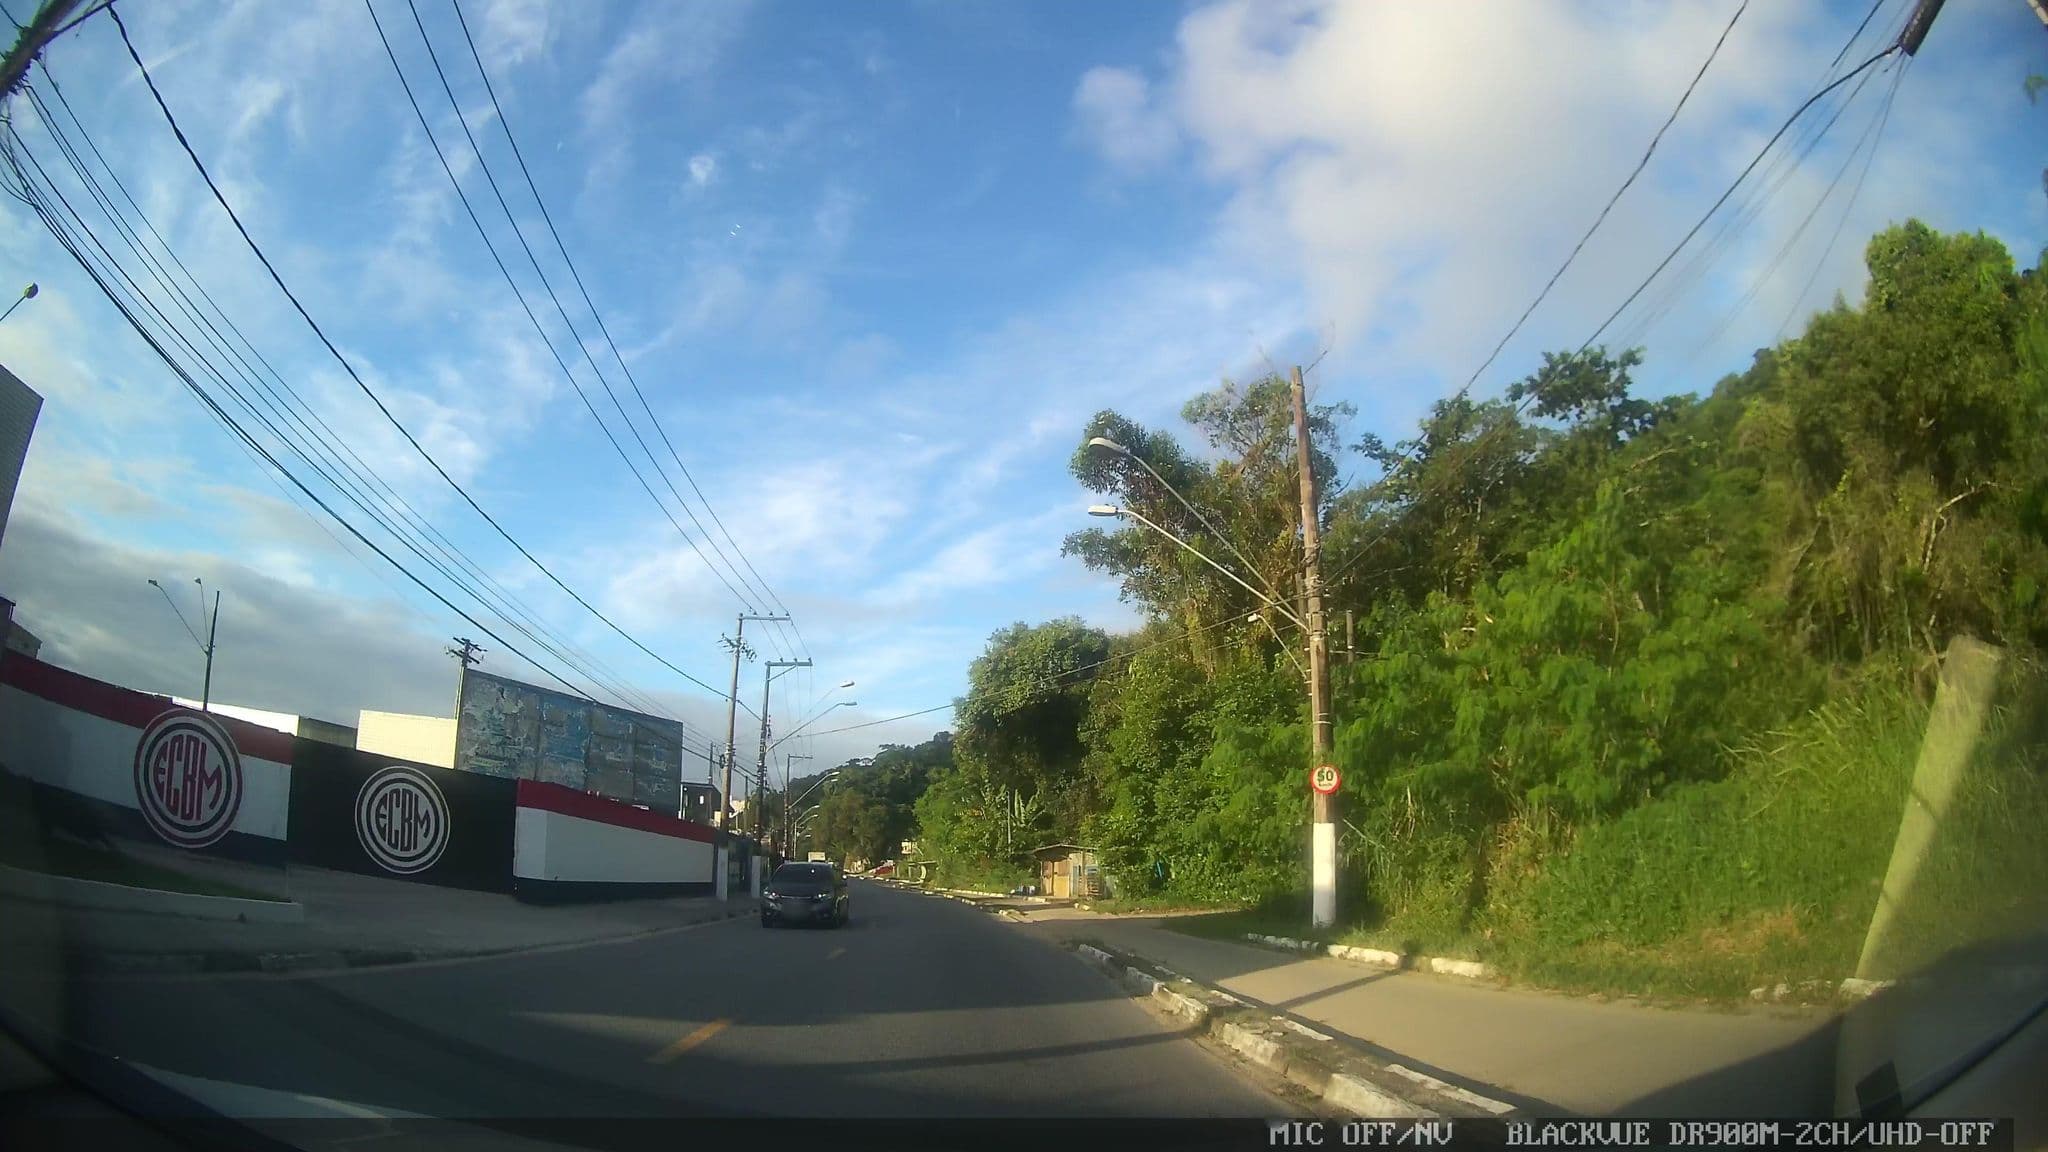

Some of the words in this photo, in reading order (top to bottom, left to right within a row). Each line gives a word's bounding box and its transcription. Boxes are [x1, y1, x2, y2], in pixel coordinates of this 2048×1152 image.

[154, 734, 222, 821] ECBM
[1317, 769, 1334, 781] 50
[375, 788, 431, 852] ECBM
